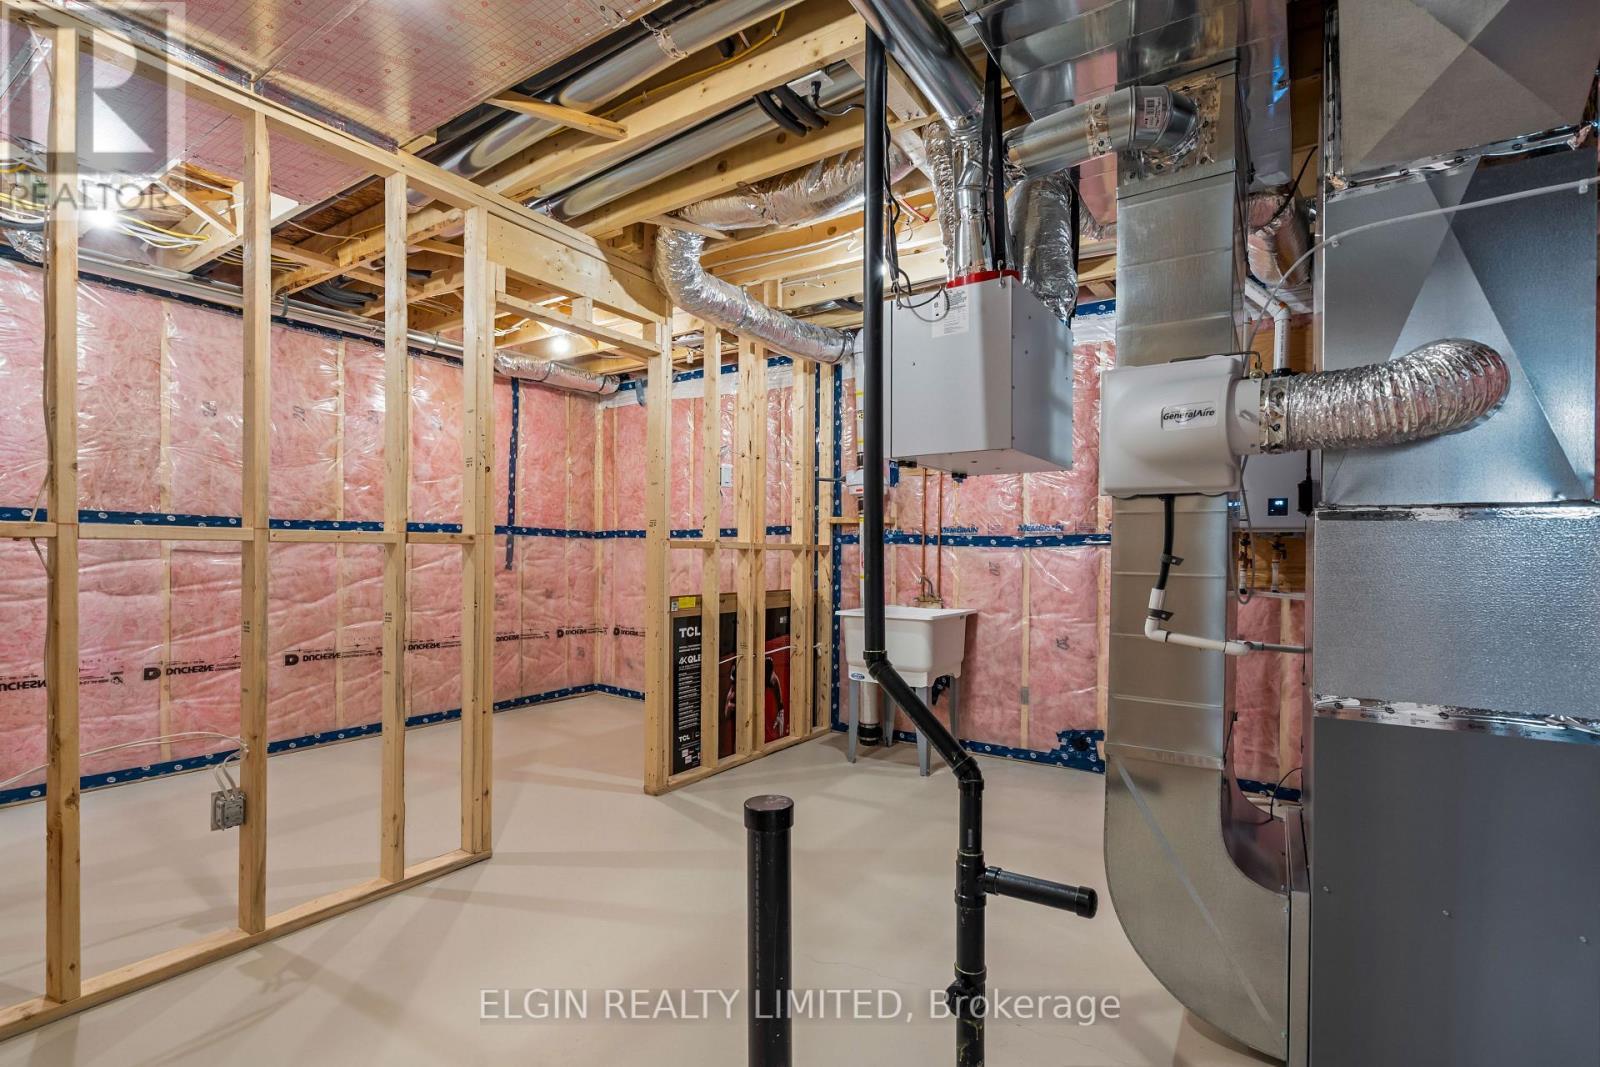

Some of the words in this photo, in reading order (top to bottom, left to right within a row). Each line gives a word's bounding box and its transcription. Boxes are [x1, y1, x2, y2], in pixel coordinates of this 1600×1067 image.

[1163, 408, 1215, 421] GeneralAire
[679, 626, 701, 639] TCL
[688, 654, 701, 664] QLE
[679, 734, 690, 743] TCL
